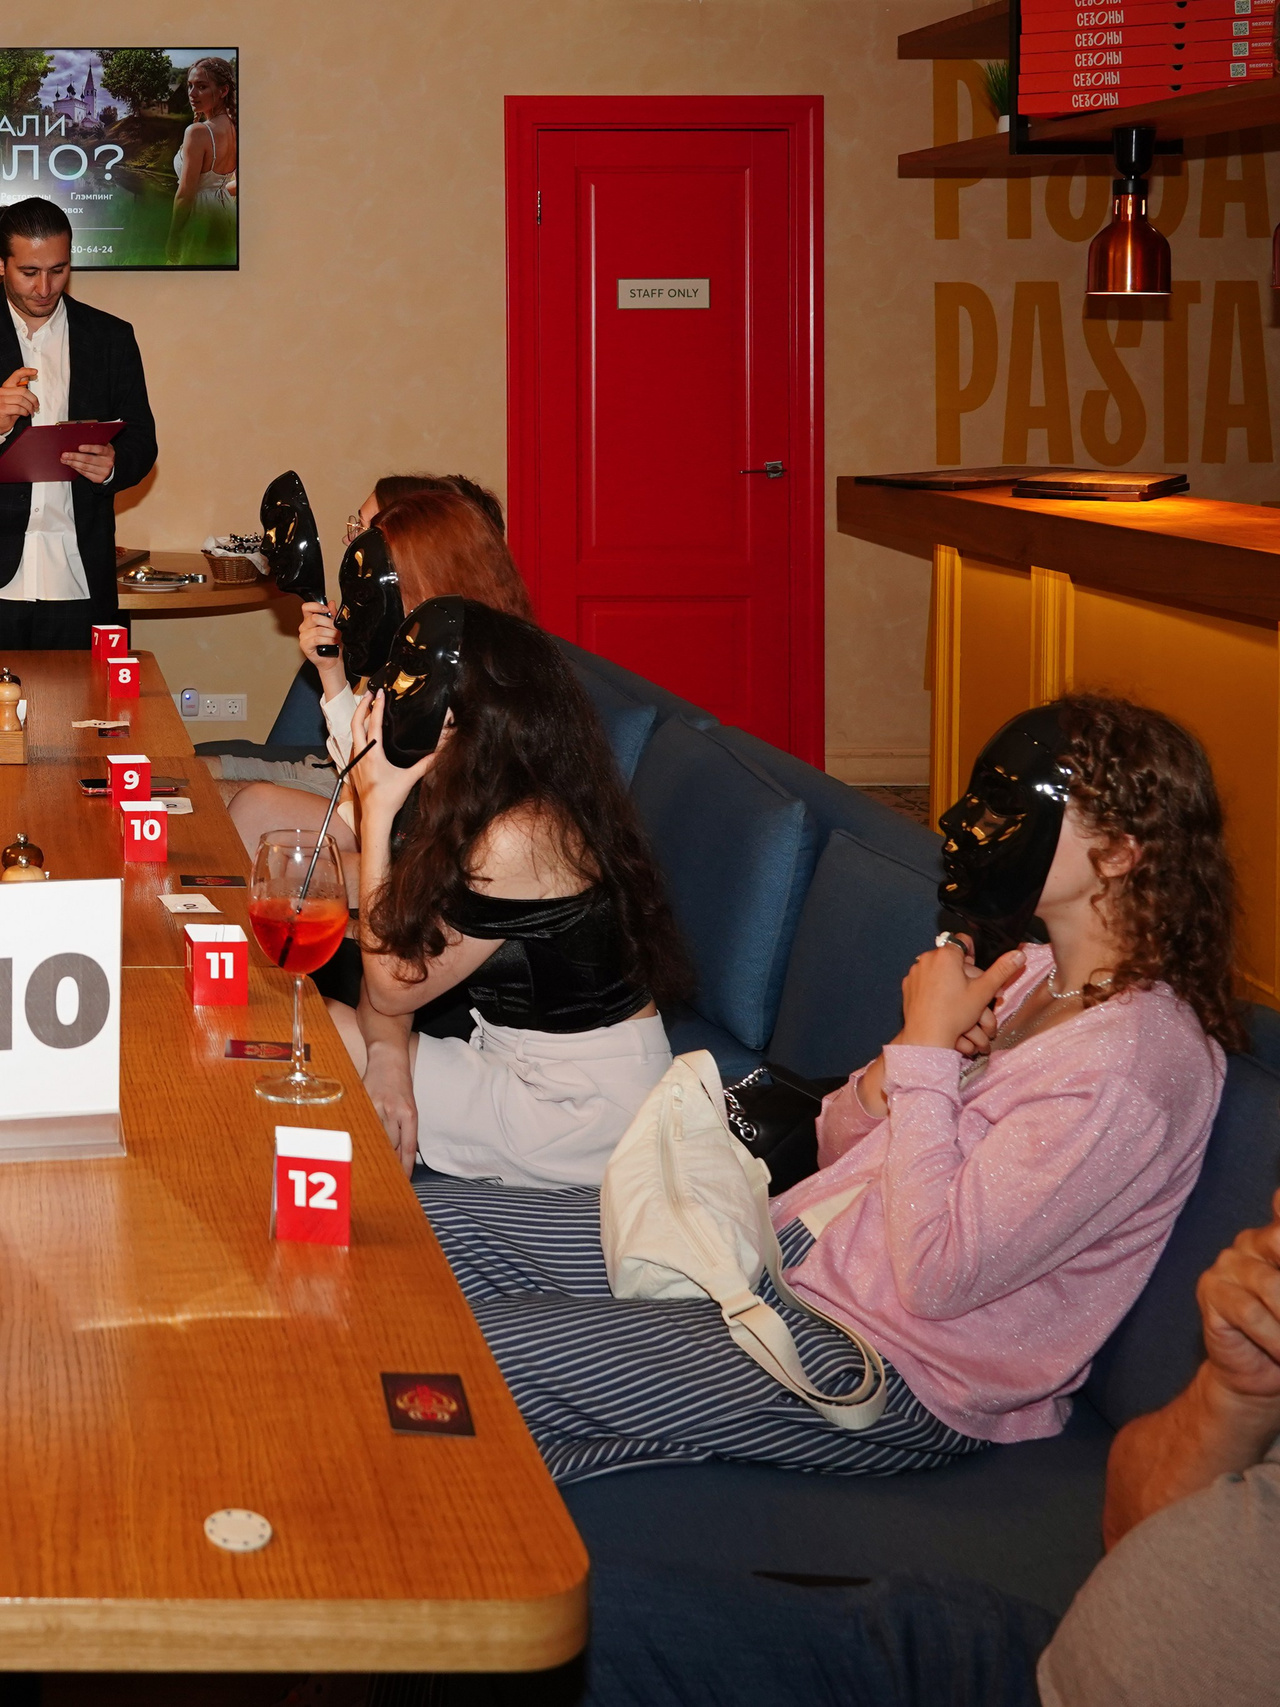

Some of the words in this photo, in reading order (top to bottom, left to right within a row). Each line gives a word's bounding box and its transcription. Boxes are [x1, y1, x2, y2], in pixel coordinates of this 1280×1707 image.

[1076, 10, 1124, 27] СЕЗОНЫ
[1075, 31, 1122, 47] СЕЗОНЫ
[1074, 51, 1122, 67] СЕЗОНЫ
[1073, 71, 1120, 87] СЕЗОНЫ
[1071, 92, 1119, 108] СЕЗОНЫ
[70, 192, 114, 201] Глэмпинг
[629, 288, 664, 298] STAFF
[667, 288, 699, 298] ONLY
[933, 280, 1274, 467] PASTA
[108, 633, 122, 648] 7
[118, 668, 131, 684] 8
[123, 769, 140, 790] 9
[130, 818, 162, 841] 10
[205, 952, 234, 979] 11
[287, 1169, 338, 1211] 12
